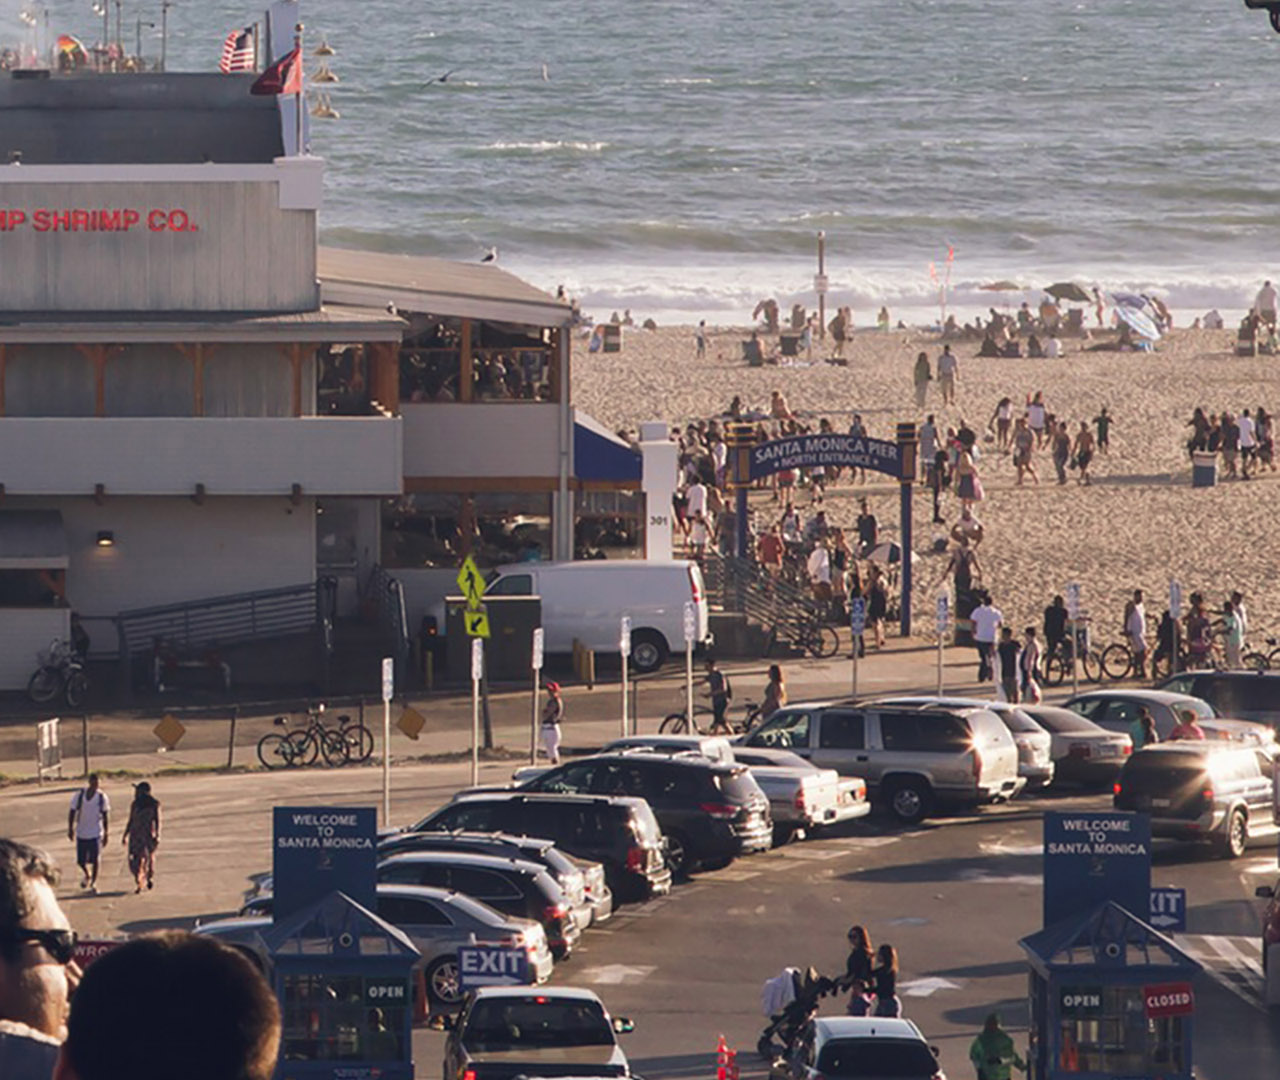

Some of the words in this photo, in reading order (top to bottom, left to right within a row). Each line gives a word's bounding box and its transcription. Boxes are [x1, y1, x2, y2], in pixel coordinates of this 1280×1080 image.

[33, 209, 140, 233] SHRIMP
[147, 209, 199, 233] CO.
[755, 441, 802, 463] SANTA
[805, 437, 865, 453] MONICA
[868, 442, 898, 460] PIER
[781, 454, 817, 467] NORTH
[819, 453, 870, 465] ENTRANCE
[650, 516, 668, 525] 301
[292, 814, 358, 826] WELCOME
[1063, 820, 1131, 831] WELCOME
[317, 826, 334, 837] TO
[1088, 831, 1106, 842] TO
[278, 837, 320, 848] SANTA
[322, 837, 373, 848] MONICA
[1048, 843, 1092, 854] SANTA
[1094, 843, 1146, 855] MONICA
[461, 950, 524, 973] EXIT
[368, 986, 404, 997] OPEN
[1063, 995, 1100, 1007] OPEN
[1147, 993, 1190, 1008] CLOSED
